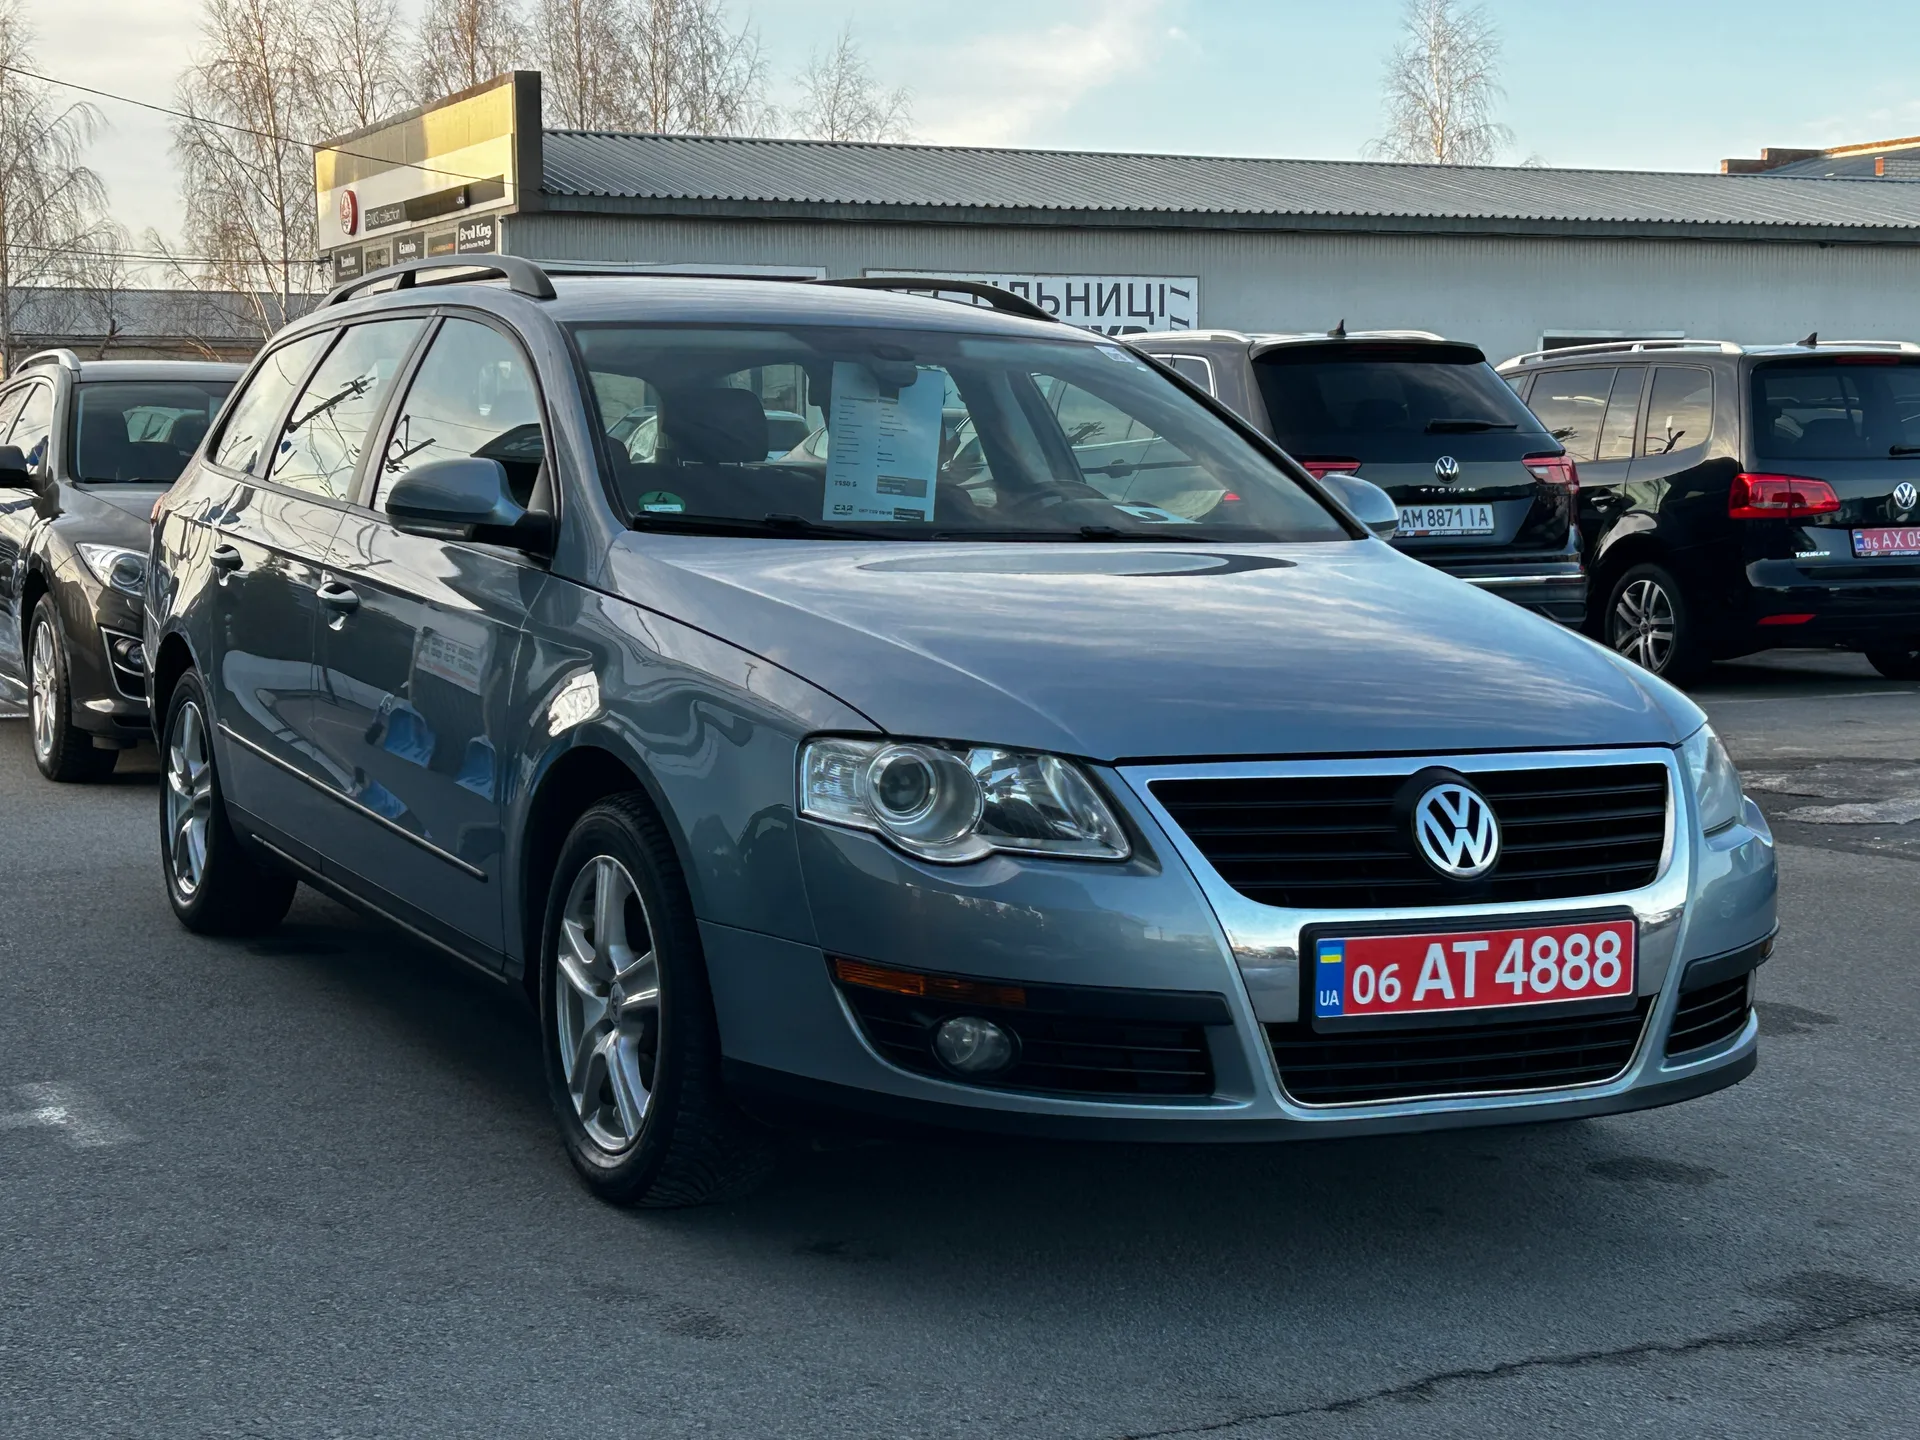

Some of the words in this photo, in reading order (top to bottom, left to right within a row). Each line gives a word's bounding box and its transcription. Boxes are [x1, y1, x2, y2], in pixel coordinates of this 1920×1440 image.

[1401, 509, 1424, 528] AM
[1427, 508, 1463, 527] 8871
[1470, 507, 1489, 527] IA
[1864, 537, 1879, 549] 06
[1882, 531, 1904, 548] AX
[1320, 990, 1339, 1007] UA
[1352, 963, 1401, 1005] 06
[1412, 940, 1489, 1001] AT
[1494, 930, 1622, 995] 4888
